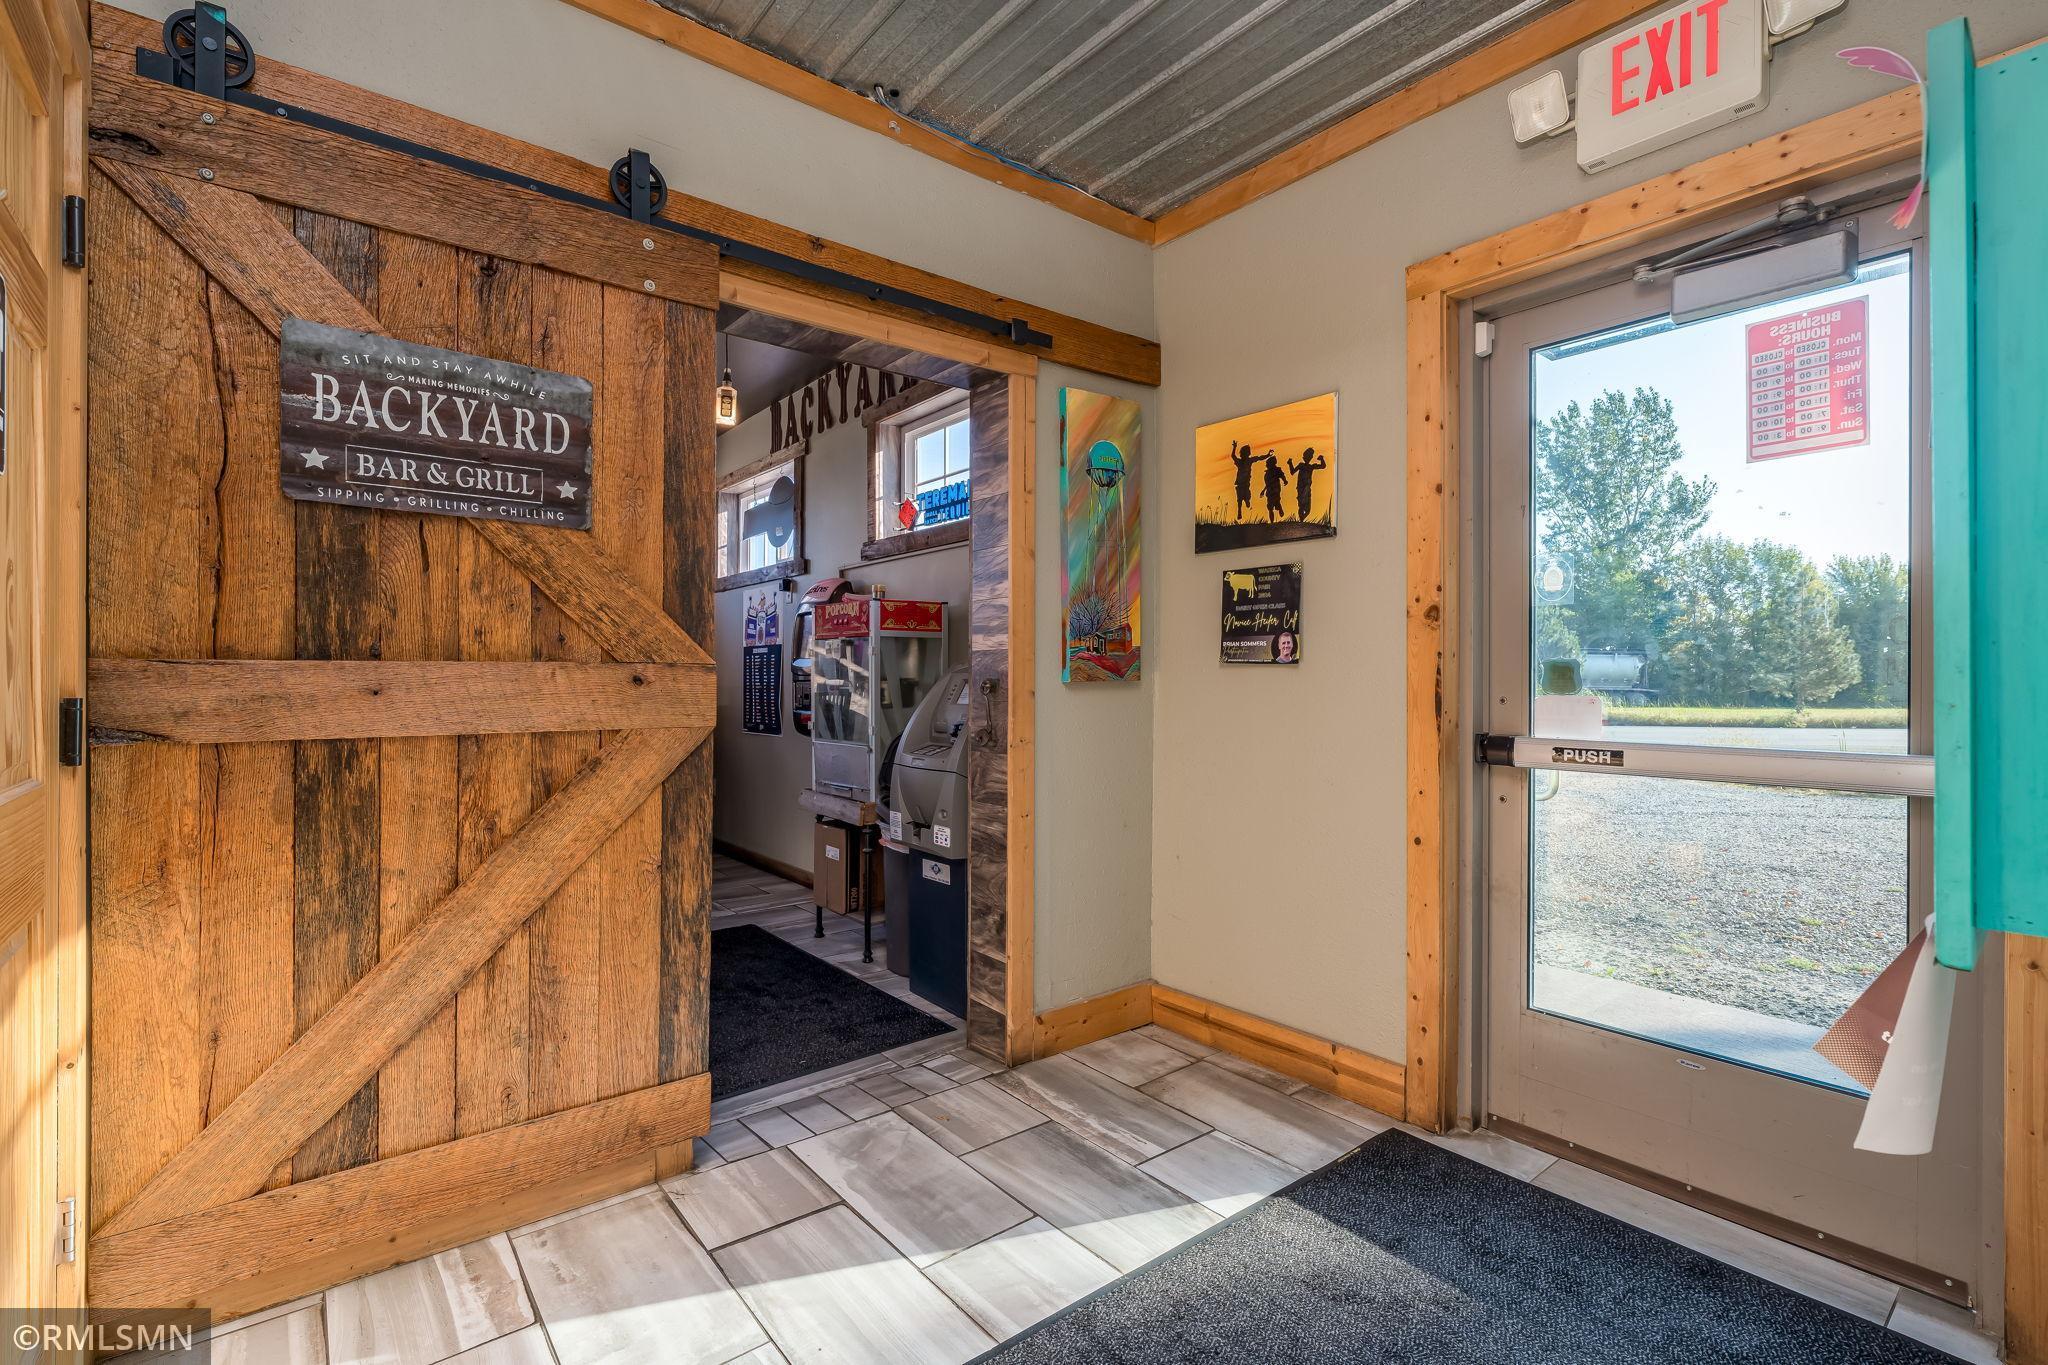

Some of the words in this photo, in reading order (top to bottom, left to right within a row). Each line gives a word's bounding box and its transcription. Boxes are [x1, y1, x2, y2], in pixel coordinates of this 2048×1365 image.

[1612, 0, 1728, 116] EXIT
[341, 354, 370, 366] SIT
[383, 354, 421, 367] AND
[432, 359, 474, 375] STAY
[483, 371, 547, 400] AWHILE
[408, 375, 445, 389] MAKING
[447, 382, 491, 396] MEMORIES
[311, 372, 570, 455] BACKYARD
[356, 453, 420, 482] BAR
[427, 462, 449, 486] &
[456, 466, 535, 496] GRILL
[317, 487, 385, 504] SIPPING
[407, 496, 479, 513] GRILLING
[499, 506, 565, 522] CHILLING
[939, 501, 970, 522] TEQUIL
[826, 601, 860, 619] POPCORN
[1563, 749, 1611, 764] PUSH
